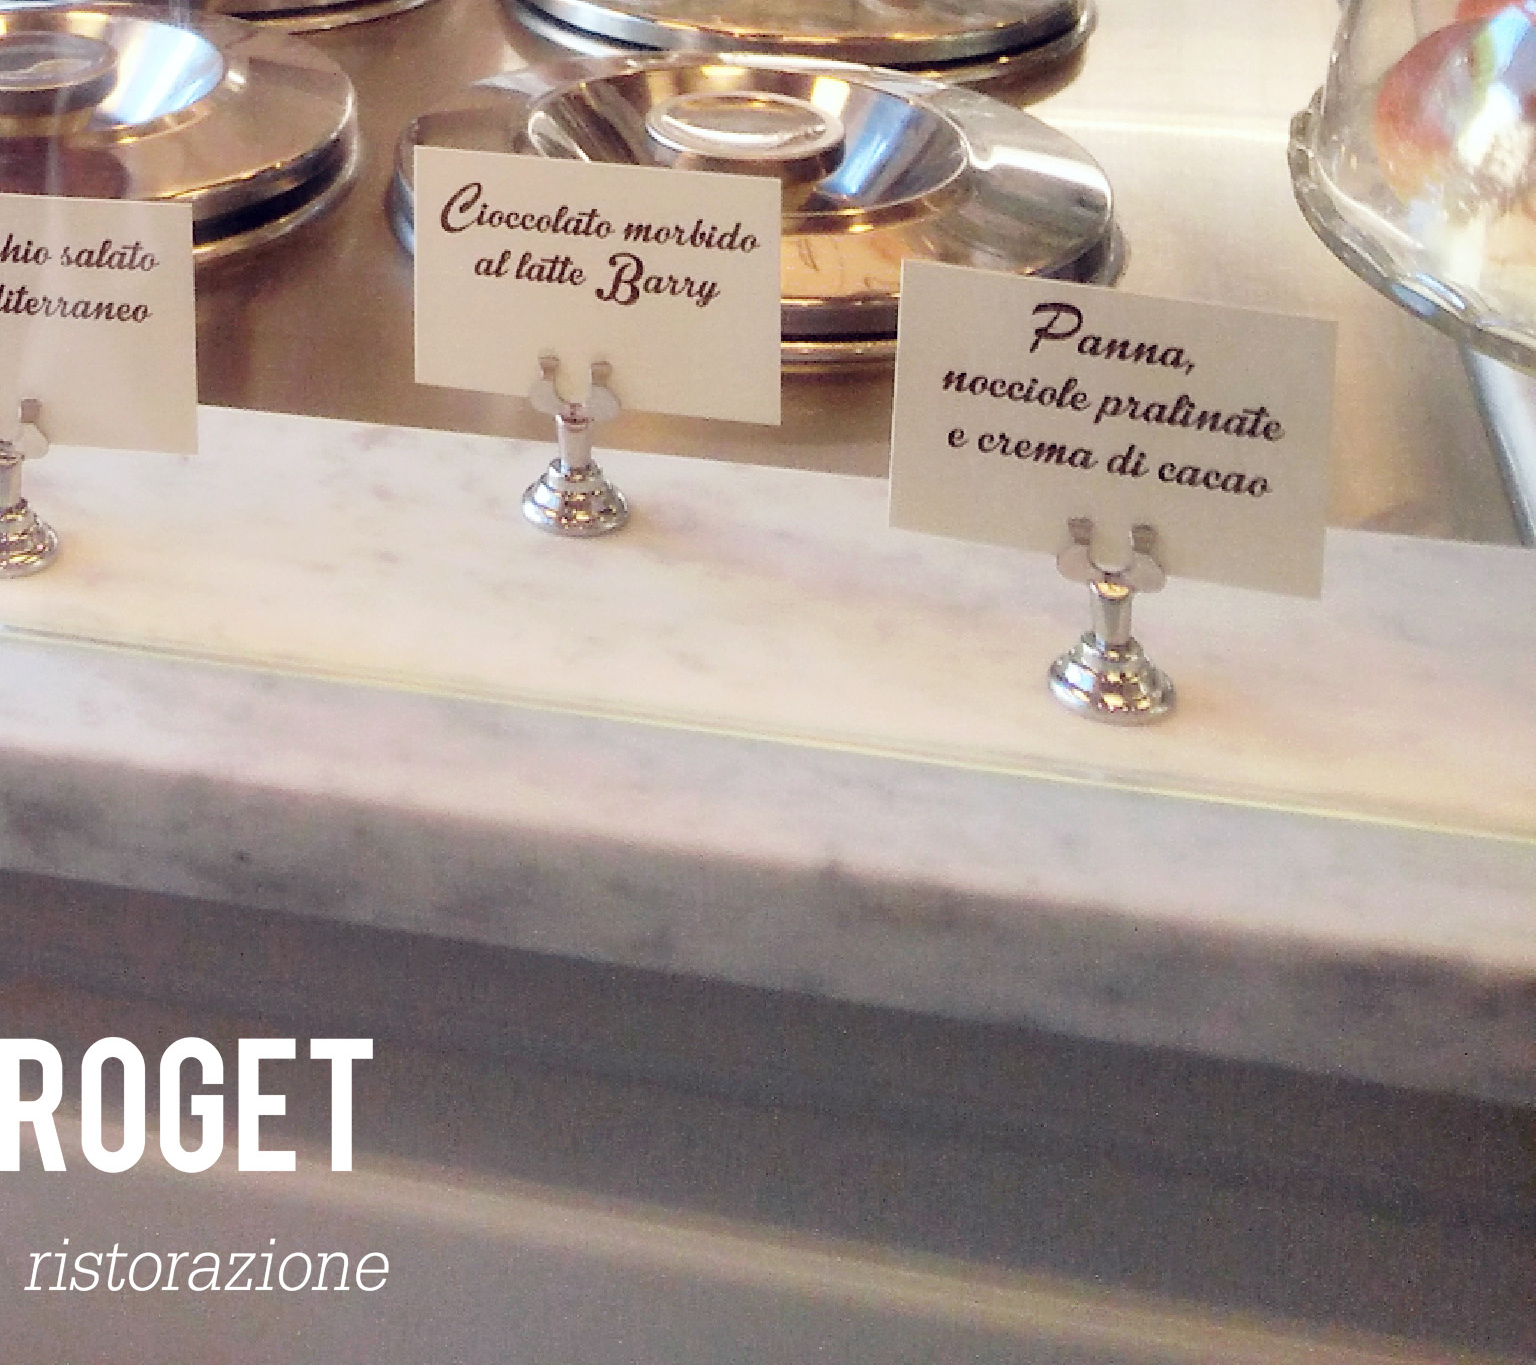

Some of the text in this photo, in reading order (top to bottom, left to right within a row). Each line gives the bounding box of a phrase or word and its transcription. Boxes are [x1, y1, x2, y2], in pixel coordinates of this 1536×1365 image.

[440, 182, 760, 254] Cioccolato morbido
[60, 240, 160, 272] salato
[474, 250, 721, 308] al latte Barry
[1030, 301, 1196, 375] Panna,
[942, 367, 1286, 443] nocciole pralinate
[948, 426, 1273, 499] e crema di cacao
